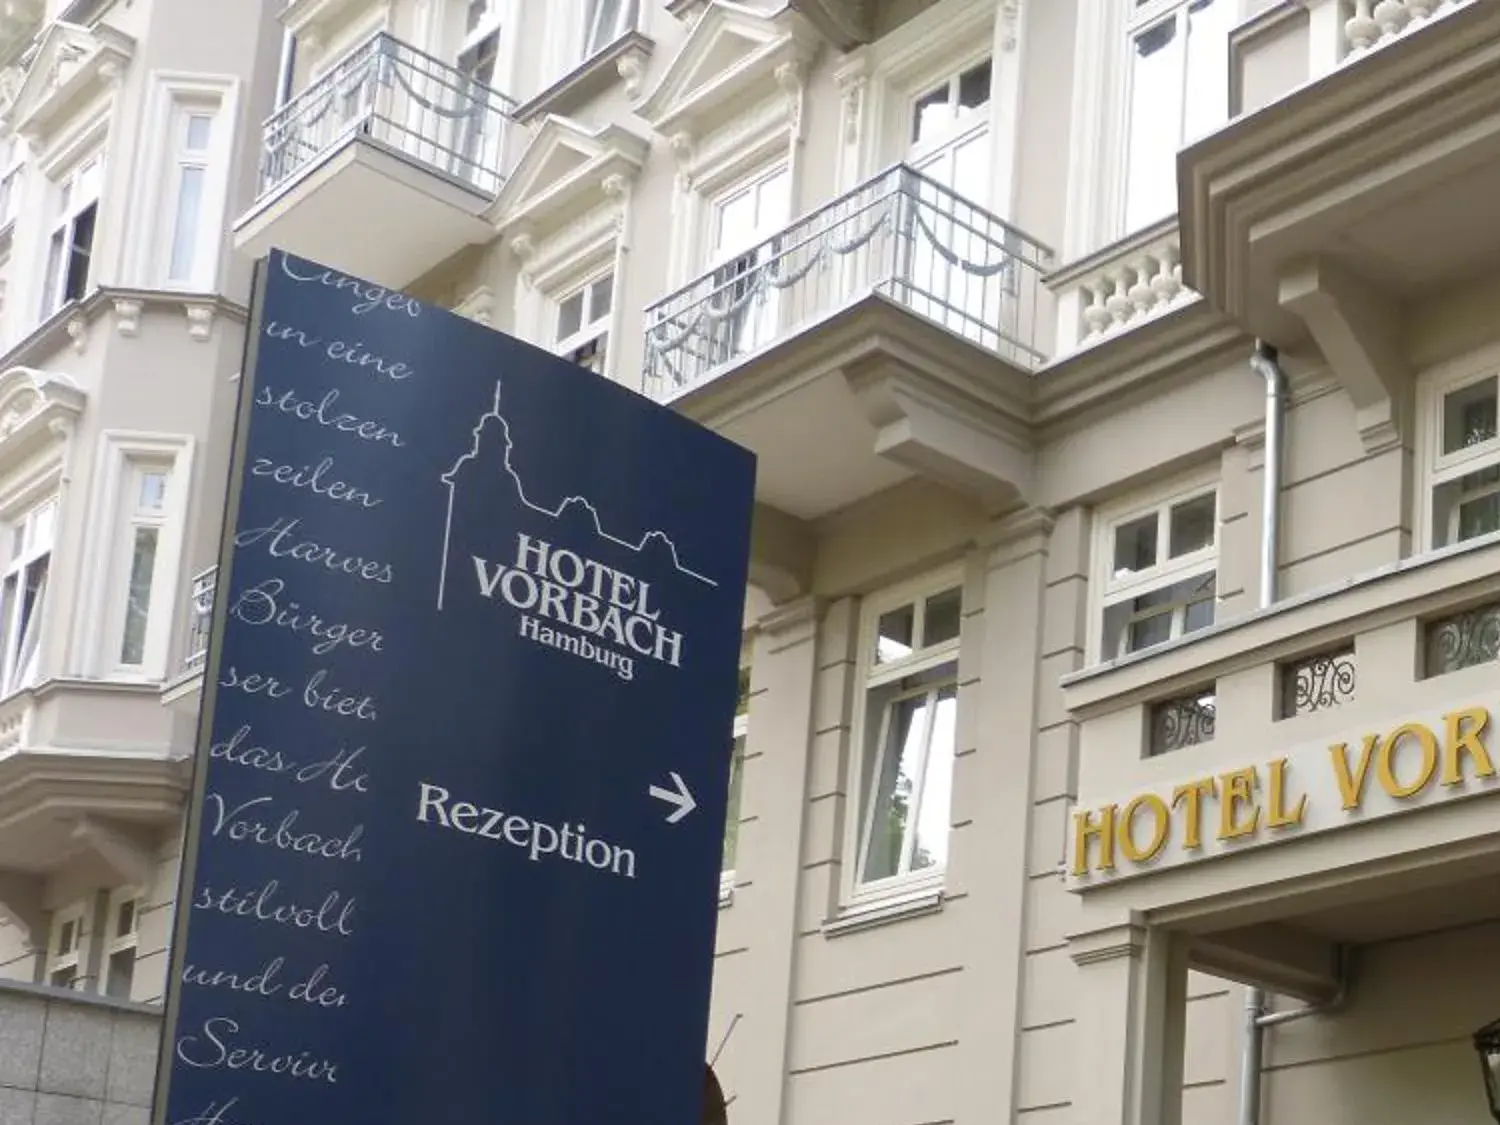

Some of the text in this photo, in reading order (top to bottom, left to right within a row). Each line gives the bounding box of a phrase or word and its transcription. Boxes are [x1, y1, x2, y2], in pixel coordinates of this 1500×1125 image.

[326, 340, 414, 380] eine
[255, 385, 406, 448] stolzen
[251, 456, 384, 508] zeilen
[234, 517, 393, 583] Harves
[517, 531, 662, 621] HOTEL
[230, 577, 385, 655] Bürger
[472, 555, 684, 668] VORBACH
[519, 614, 635, 681] Hamburg
[219, 666, 294, 698] ser
[209, 723, 292, 772] das
[207, 793, 365, 863] Vorbach
[415, 780, 638, 880] Rezeption
[1071, 754, 1308, 877] HOTEL
[193, 879, 356, 936] stilvoll
[181, 956, 285, 996] und
